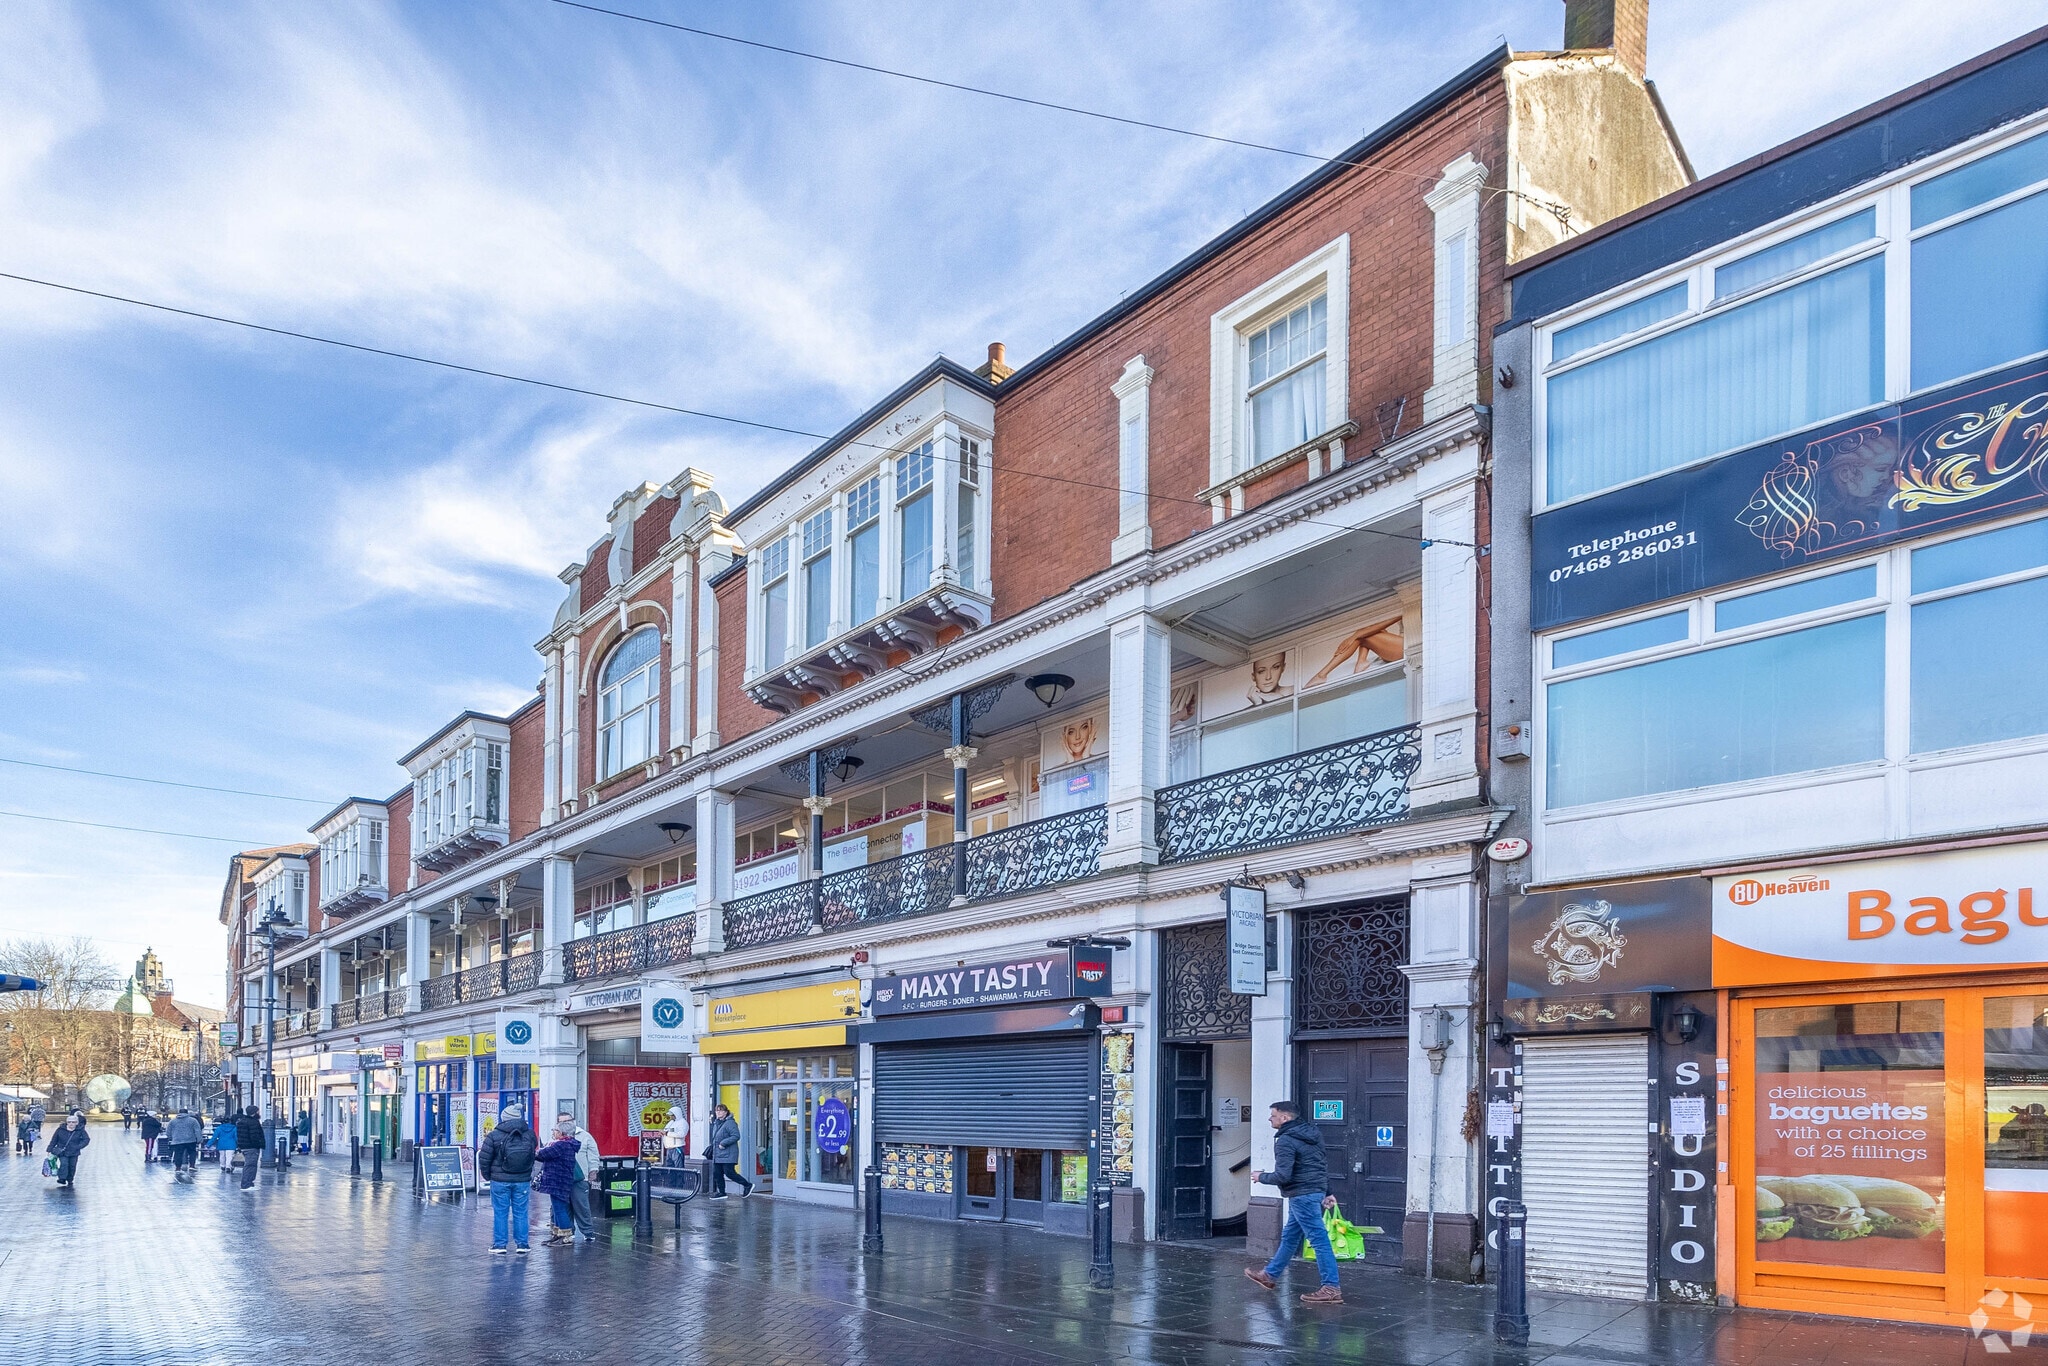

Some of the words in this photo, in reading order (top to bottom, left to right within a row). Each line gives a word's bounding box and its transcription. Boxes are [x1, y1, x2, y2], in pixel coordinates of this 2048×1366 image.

[1986, 403, 2008, 420] THE
[1567, 521, 1677, 559] Telephone
[1549, 554, 1611, 582] 07468
[1617, 531, 1697, 564] 286031
[827, 850, 840, 859] The
[842, 845, 859, 855] Best
[860, 832, 903, 849] Connection
[762, 862, 797, 883] 639000
[1734, 883, 1758, 903] BU
[1765, 878, 1830, 896] Heaven
[1231, 909, 1264, 921] VICTORIAN
[1239, 919, 1257, 928] ARCADE
[1847, 888, 2048, 945] Bagu
[901, 971, 966, 1001] MAXY
[970, 961, 1053, 992] TASTY
[1081, 970, 1103, 981] TASTY
[584, 992, 620, 1007] VICTORIAN
[843, 995, 856, 1003] Care
[920, 999, 948, 1009] BURGERS
[952, 997, 974, 1005] DONER
[979, 992, 1018, 1003] SHAWARMA
[1023, 988, 1052, 998] FALAFEL
[663, 1008, 673, 1020] V
[714, 1013, 746, 1023] Marketplace
[514, 1028, 522, 1037] V
[651, 1086, 681, 1097] SALE
[1768, 1086, 1866, 1099] delicious
[820, 1107, 845, 1115] Everything
[1319, 1102, 1338, 1110] Fire
[1769, 1102, 1928, 1125] baguettes
[818, 1115, 847, 1138] £2.99
[1775, 1126, 1821, 1139] with
[1827, 1129, 1842, 1139] a
[1848, 1126, 1927, 1140] choice
[1487, 1067, 1514, 1250] TTT
[1794, 1144, 1815, 1157] of
[1821, 1145, 1846, 1158] 25
[1852, 1144, 1928, 1163] fillings
[1670, 1062, 1706, 1264] SUDIO
